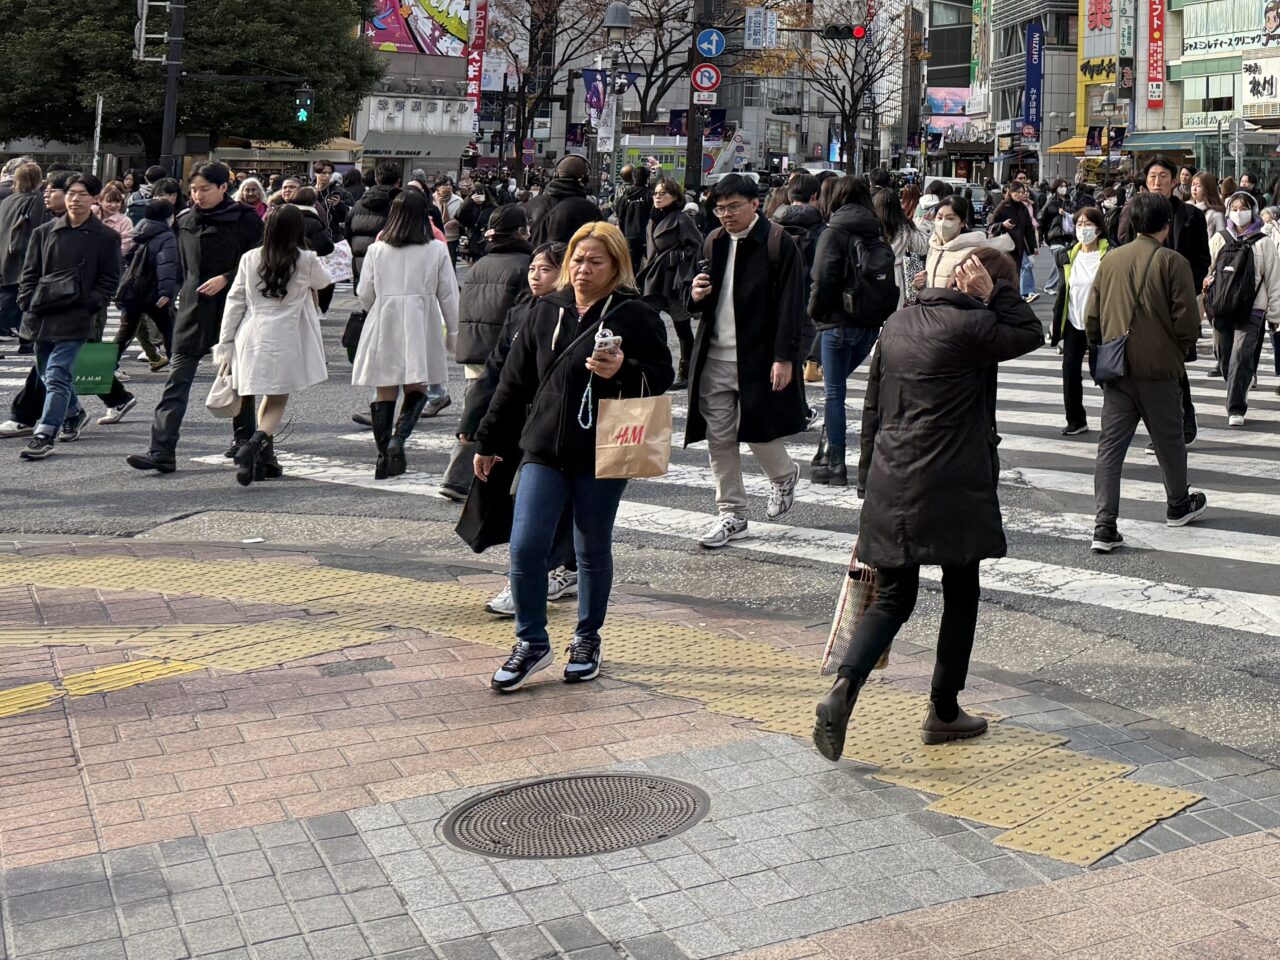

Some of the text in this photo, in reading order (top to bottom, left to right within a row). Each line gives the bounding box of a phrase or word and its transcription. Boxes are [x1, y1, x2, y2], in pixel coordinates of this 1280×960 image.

[475, 11, 485, 36] アコム
[1032, 33, 1040, 65] MIZUHO
[1029, 88, 1037, 122] みずほ銀行
[615, 425, 644, 445] H&M
